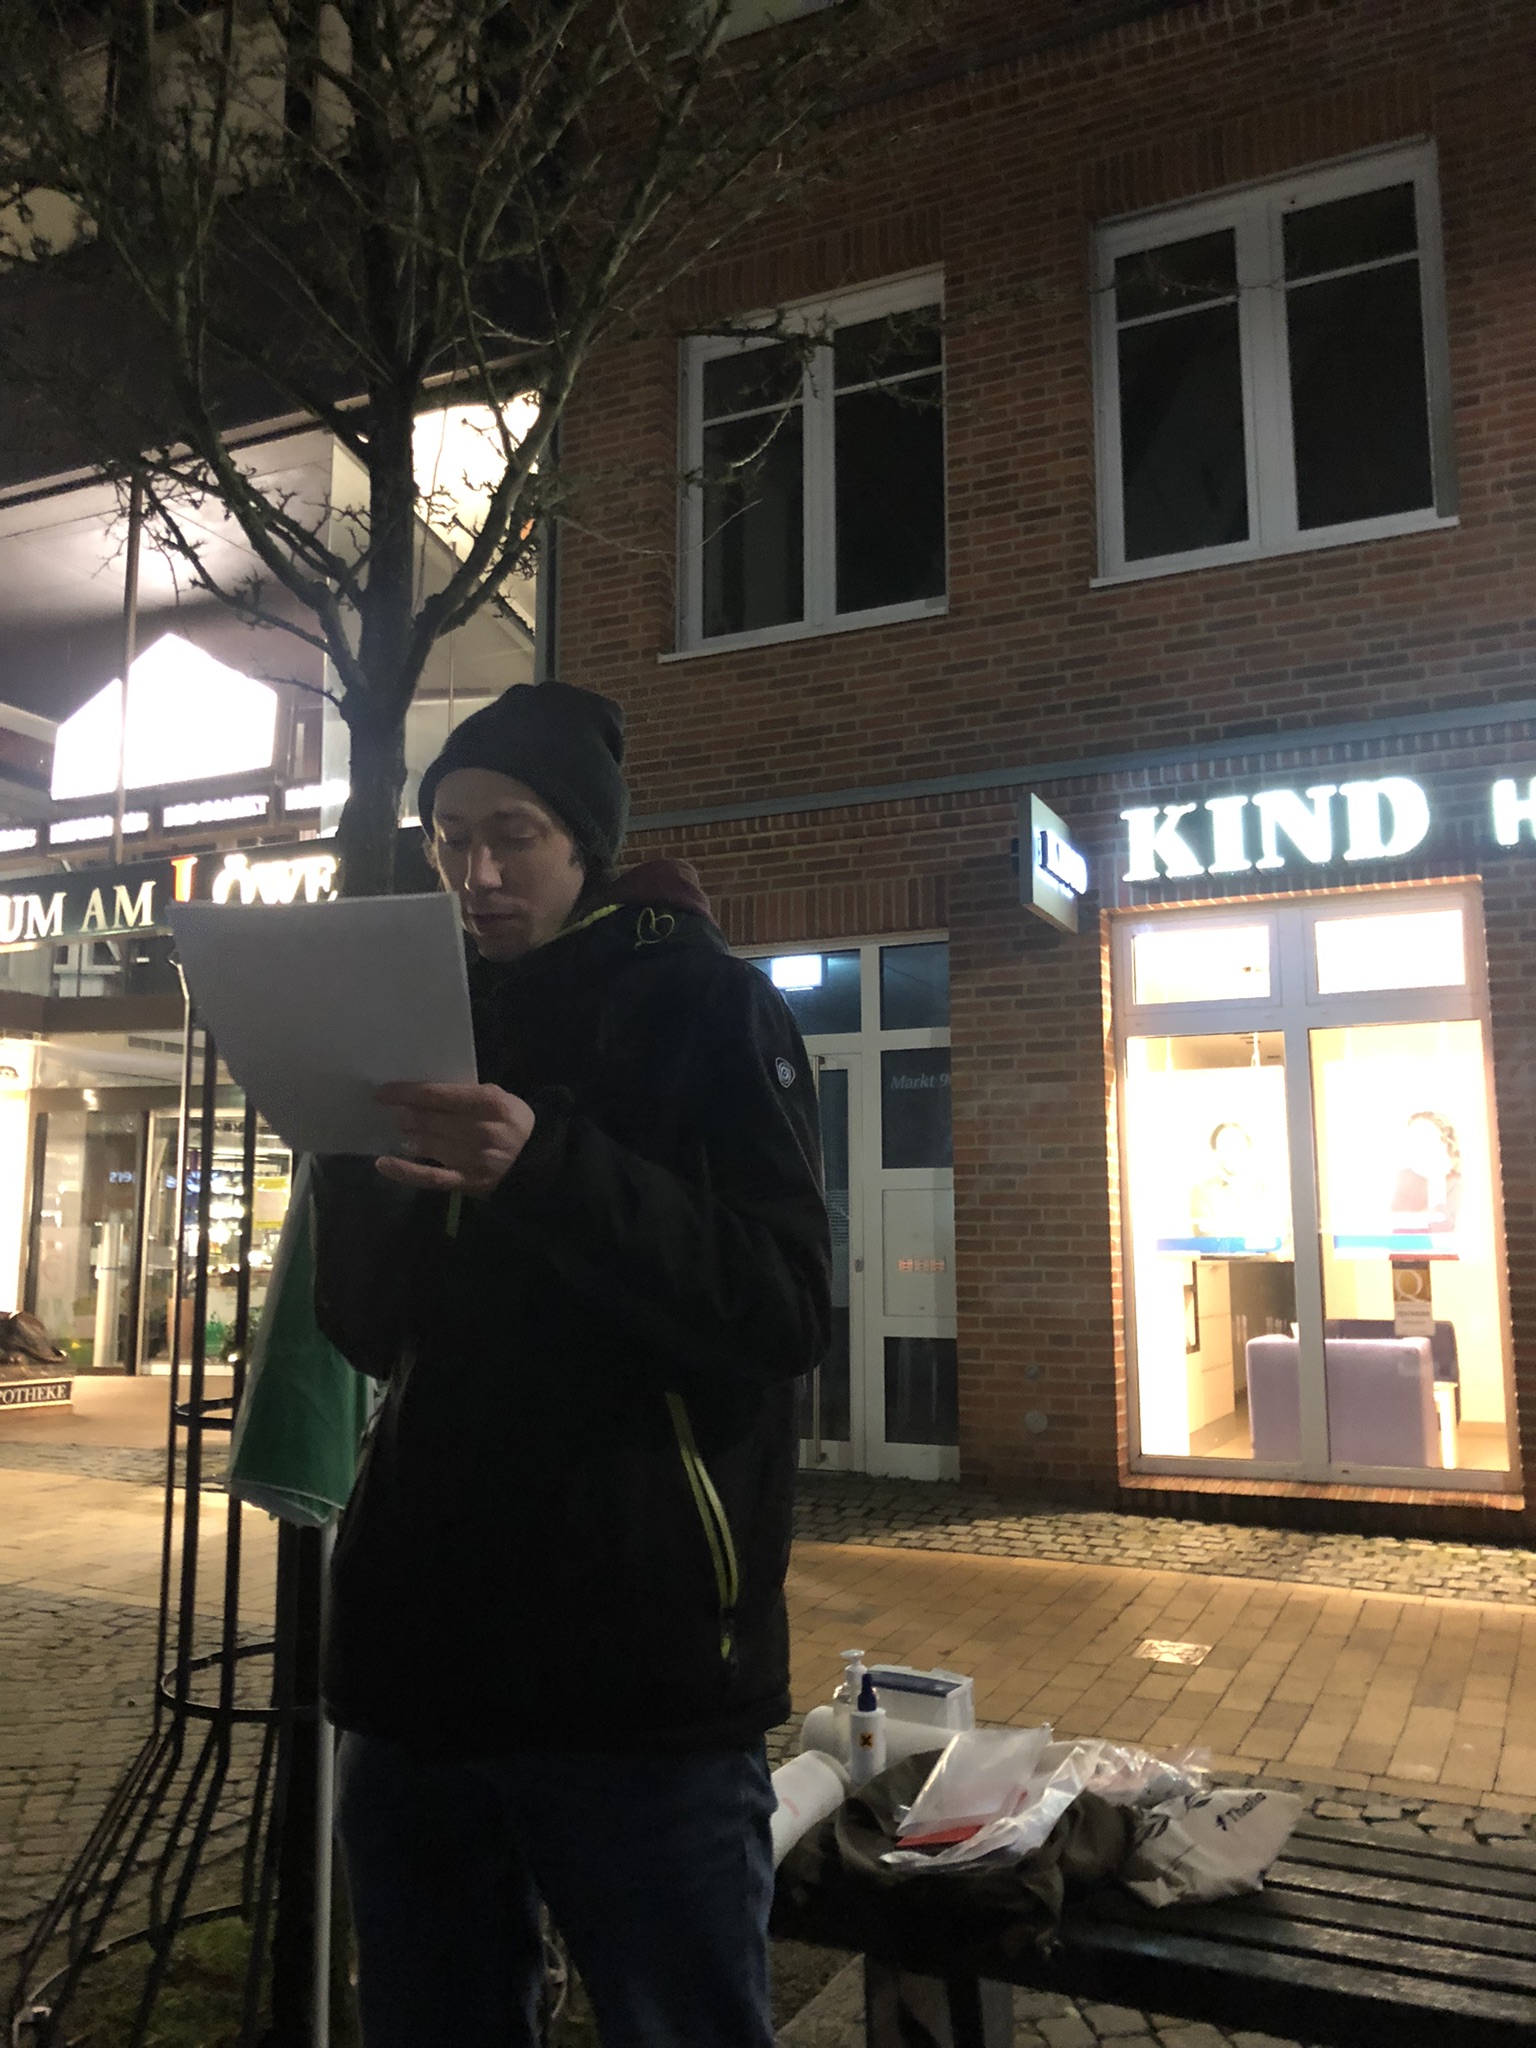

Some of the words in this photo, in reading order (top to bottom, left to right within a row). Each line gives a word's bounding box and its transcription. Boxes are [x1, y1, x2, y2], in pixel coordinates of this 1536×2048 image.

[1120, 776, 1430, 882] KIND
[78, 881, 157, 933] AM
[890, 1073, 935, 1090] Markt
[0, 1384, 67, 1405] OTHEKE
